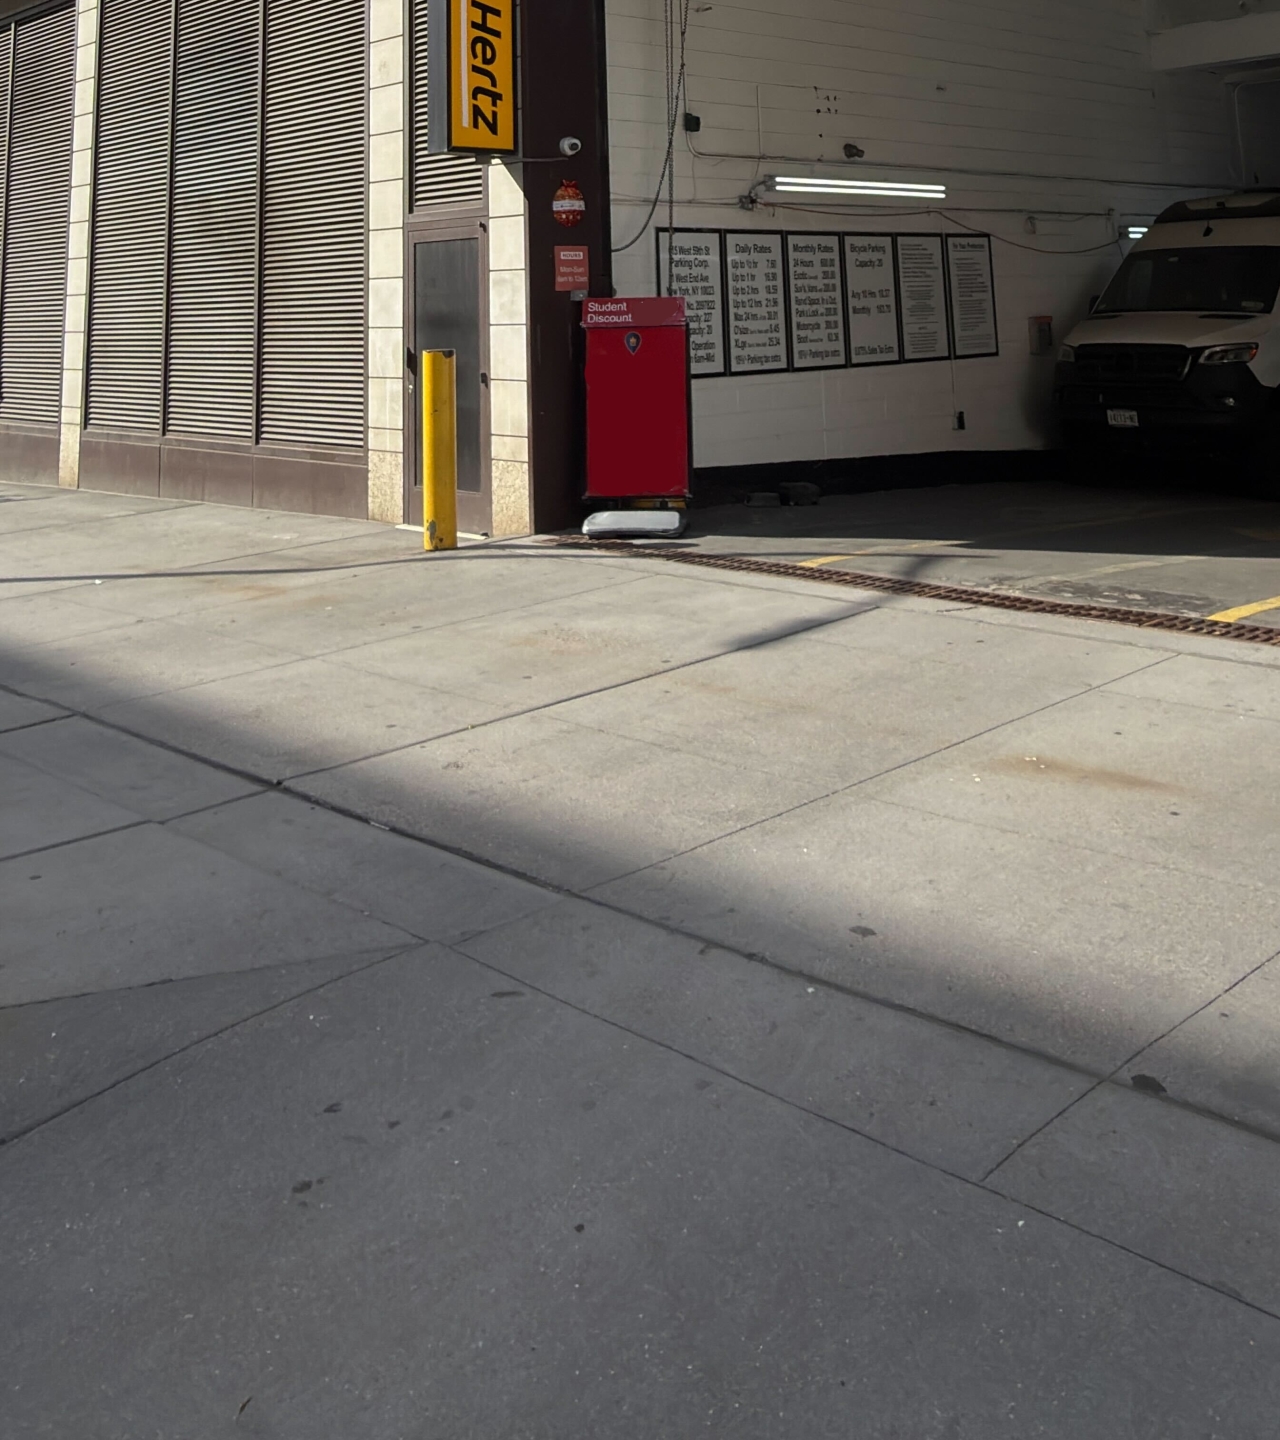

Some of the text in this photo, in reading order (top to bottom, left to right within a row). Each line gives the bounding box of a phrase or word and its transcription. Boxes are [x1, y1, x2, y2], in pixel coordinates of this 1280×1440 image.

[735, 244, 772, 255] Daily Rates
[793, 244, 834, 255] Monthly Rates
[850, 243, 886, 255] Bicycle Parking
[694, 257, 709, 269] Corp.
[731, 259, 739, 271] Up
[740, 259, 745, 268] to
[753, 259, 758, 268] hr
[800, 258, 814, 267] Hours
[732, 272, 739, 283] Up
[750, 272, 756, 281] hr
[692, 286, 699, 295] NY
[732, 285, 740, 296] Up
[751, 285, 759, 294] hrs
[588, 302, 627, 311] Student
[733, 298, 740, 310] Up
[747, 298, 753, 307] 12
[754, 298, 762, 307] hrs
[587, 314, 632, 323] Discount
